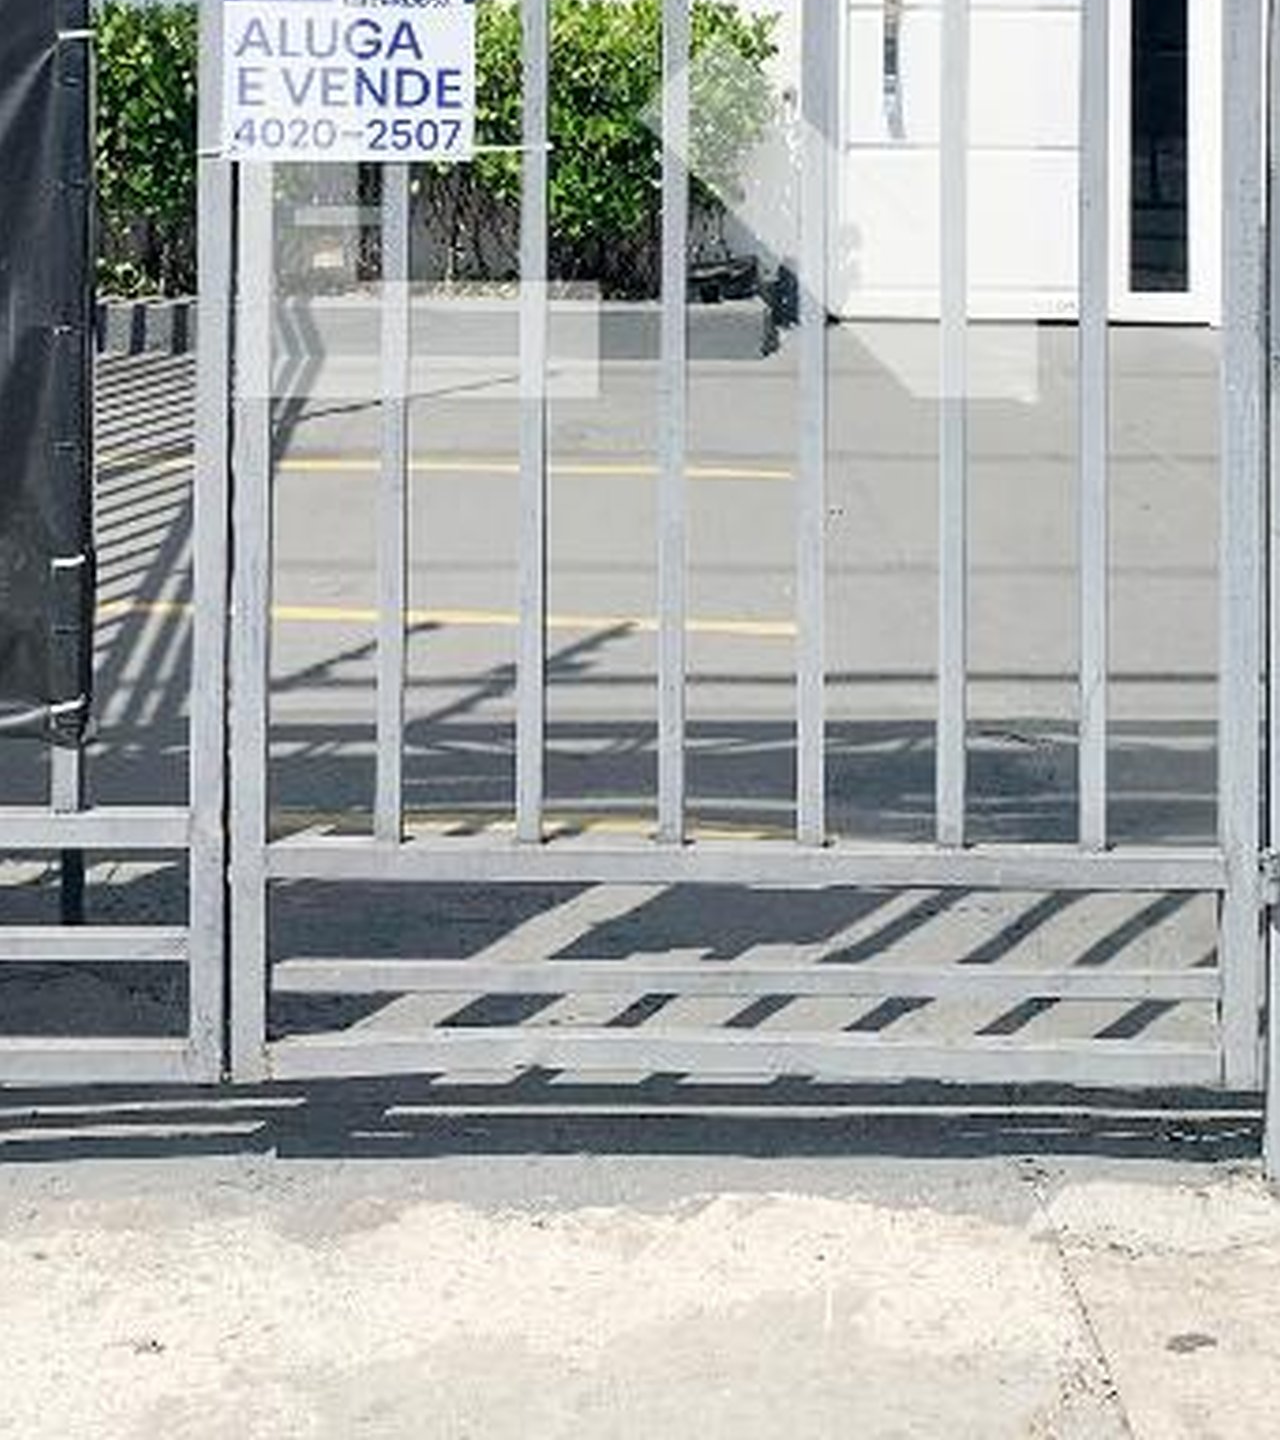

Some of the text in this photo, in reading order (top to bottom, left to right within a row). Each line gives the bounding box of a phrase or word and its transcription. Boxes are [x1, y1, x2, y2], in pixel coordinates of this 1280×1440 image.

[234, 17, 423, 60] ALUGA
[237, 67, 462, 109] E VENDE
[234, 118, 462, 151] 4020-2507
